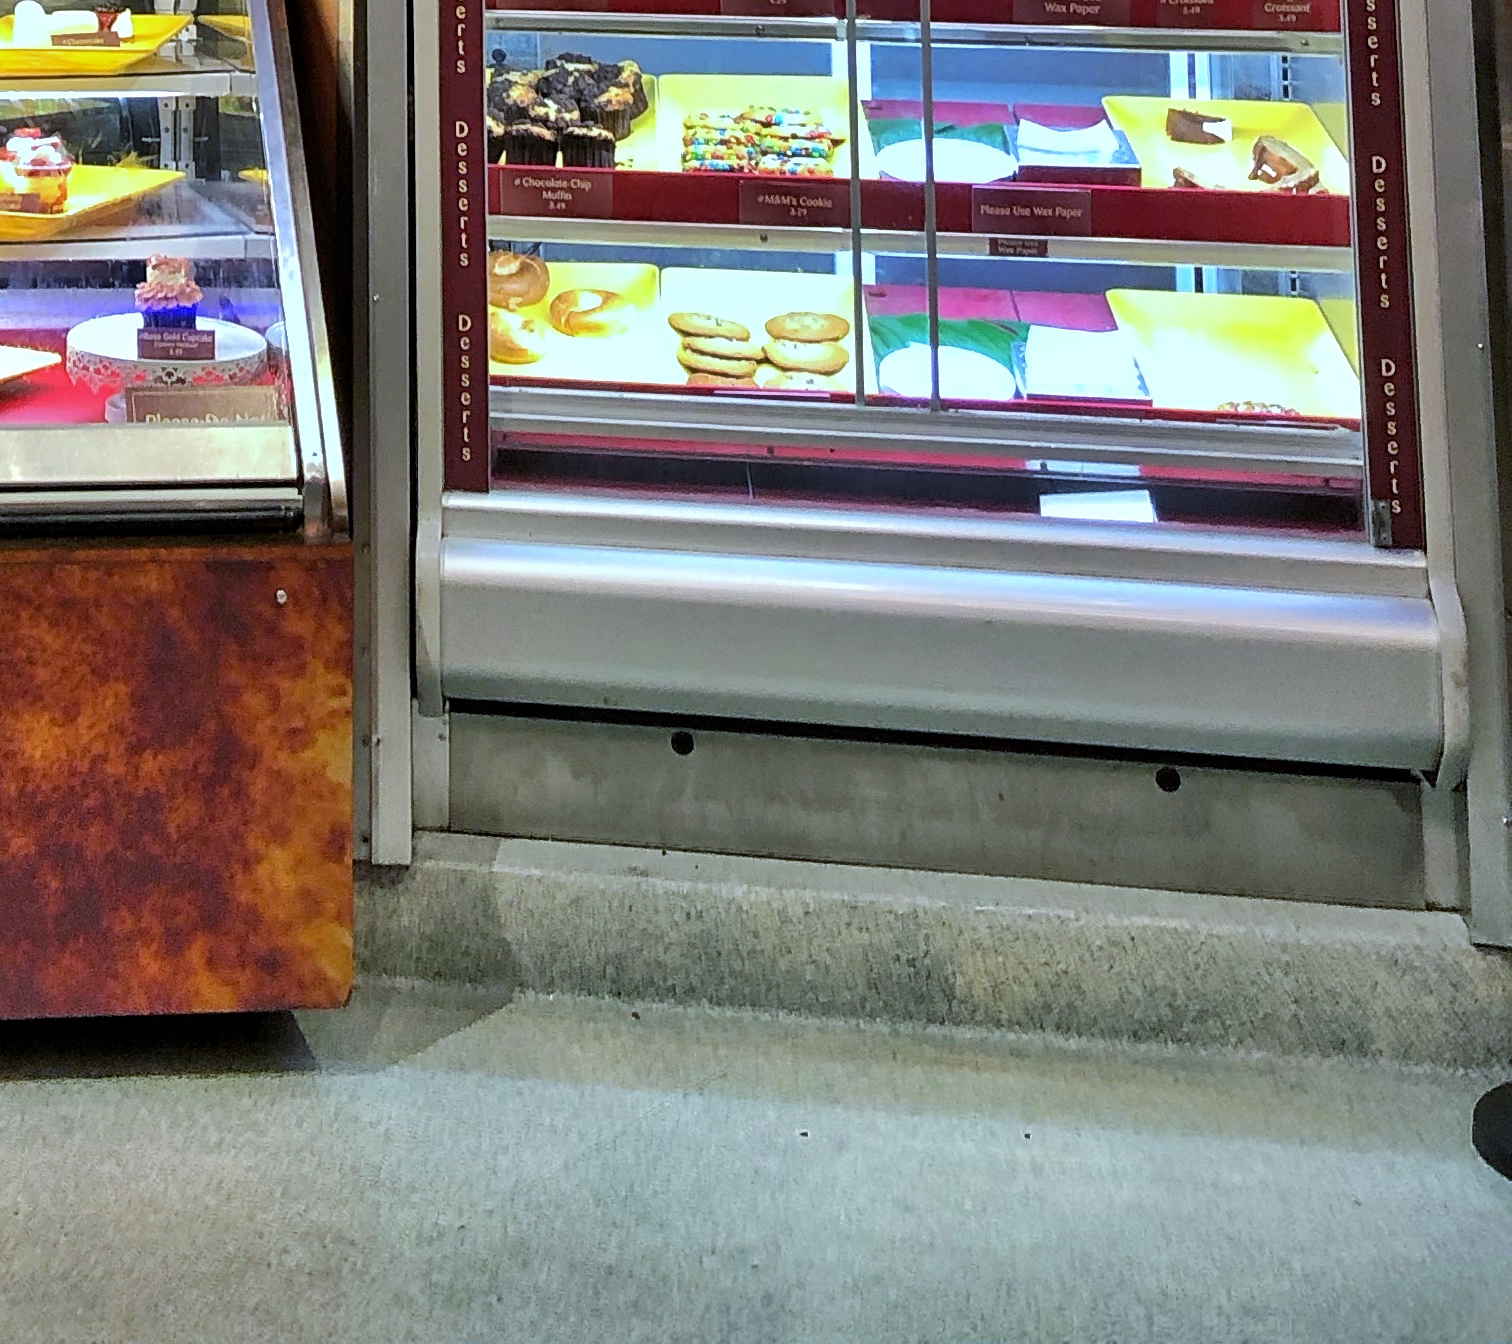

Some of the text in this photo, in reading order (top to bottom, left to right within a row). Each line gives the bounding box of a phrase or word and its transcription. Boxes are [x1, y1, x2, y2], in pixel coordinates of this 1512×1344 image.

[1044, 2, 1101, 16] Wax Paper
[1264, 2, 1311, 12] Croissant
[522, 177, 592, 191] Chocolate Chip
[456, 121, 470, 267] Desserts
[542, 191, 572, 200] Muffin
[800, 197, 832, 208] Cookie
[980, 204, 1083, 219] Please Use Wax Paper
[1371, 156, 1390, 310] Desserts
[458, 314, 472, 462] Desserts
[1380, 358, 1402, 514] Desserts
